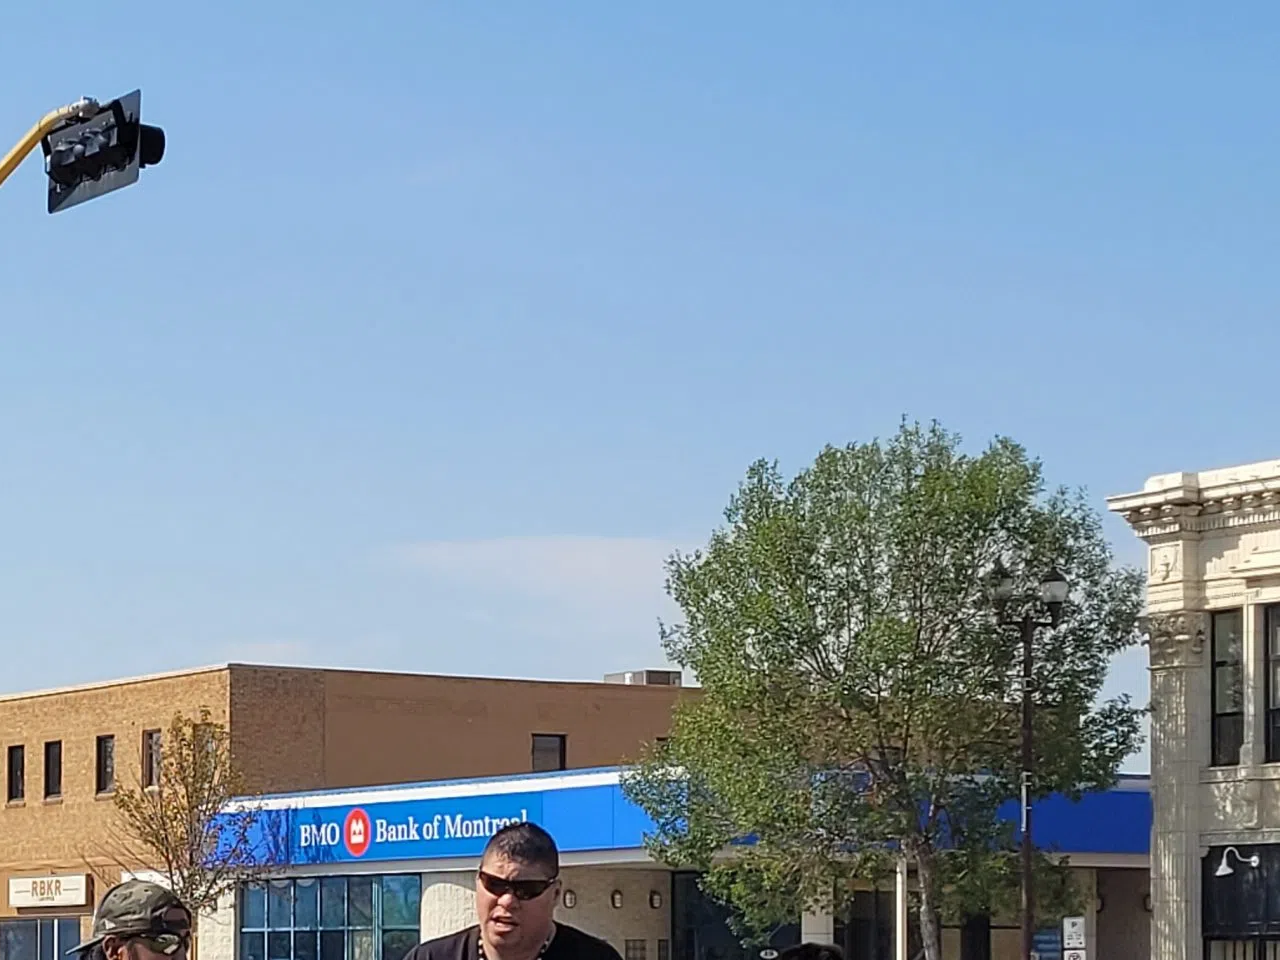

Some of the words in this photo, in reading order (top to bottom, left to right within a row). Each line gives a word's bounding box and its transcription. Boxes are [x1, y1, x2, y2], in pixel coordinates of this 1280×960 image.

[300, 822, 340, 847] BMO
[375, 816, 420, 843] Bank
[422, 812, 442, 839] of
[31, 879, 62, 897] RBKR
